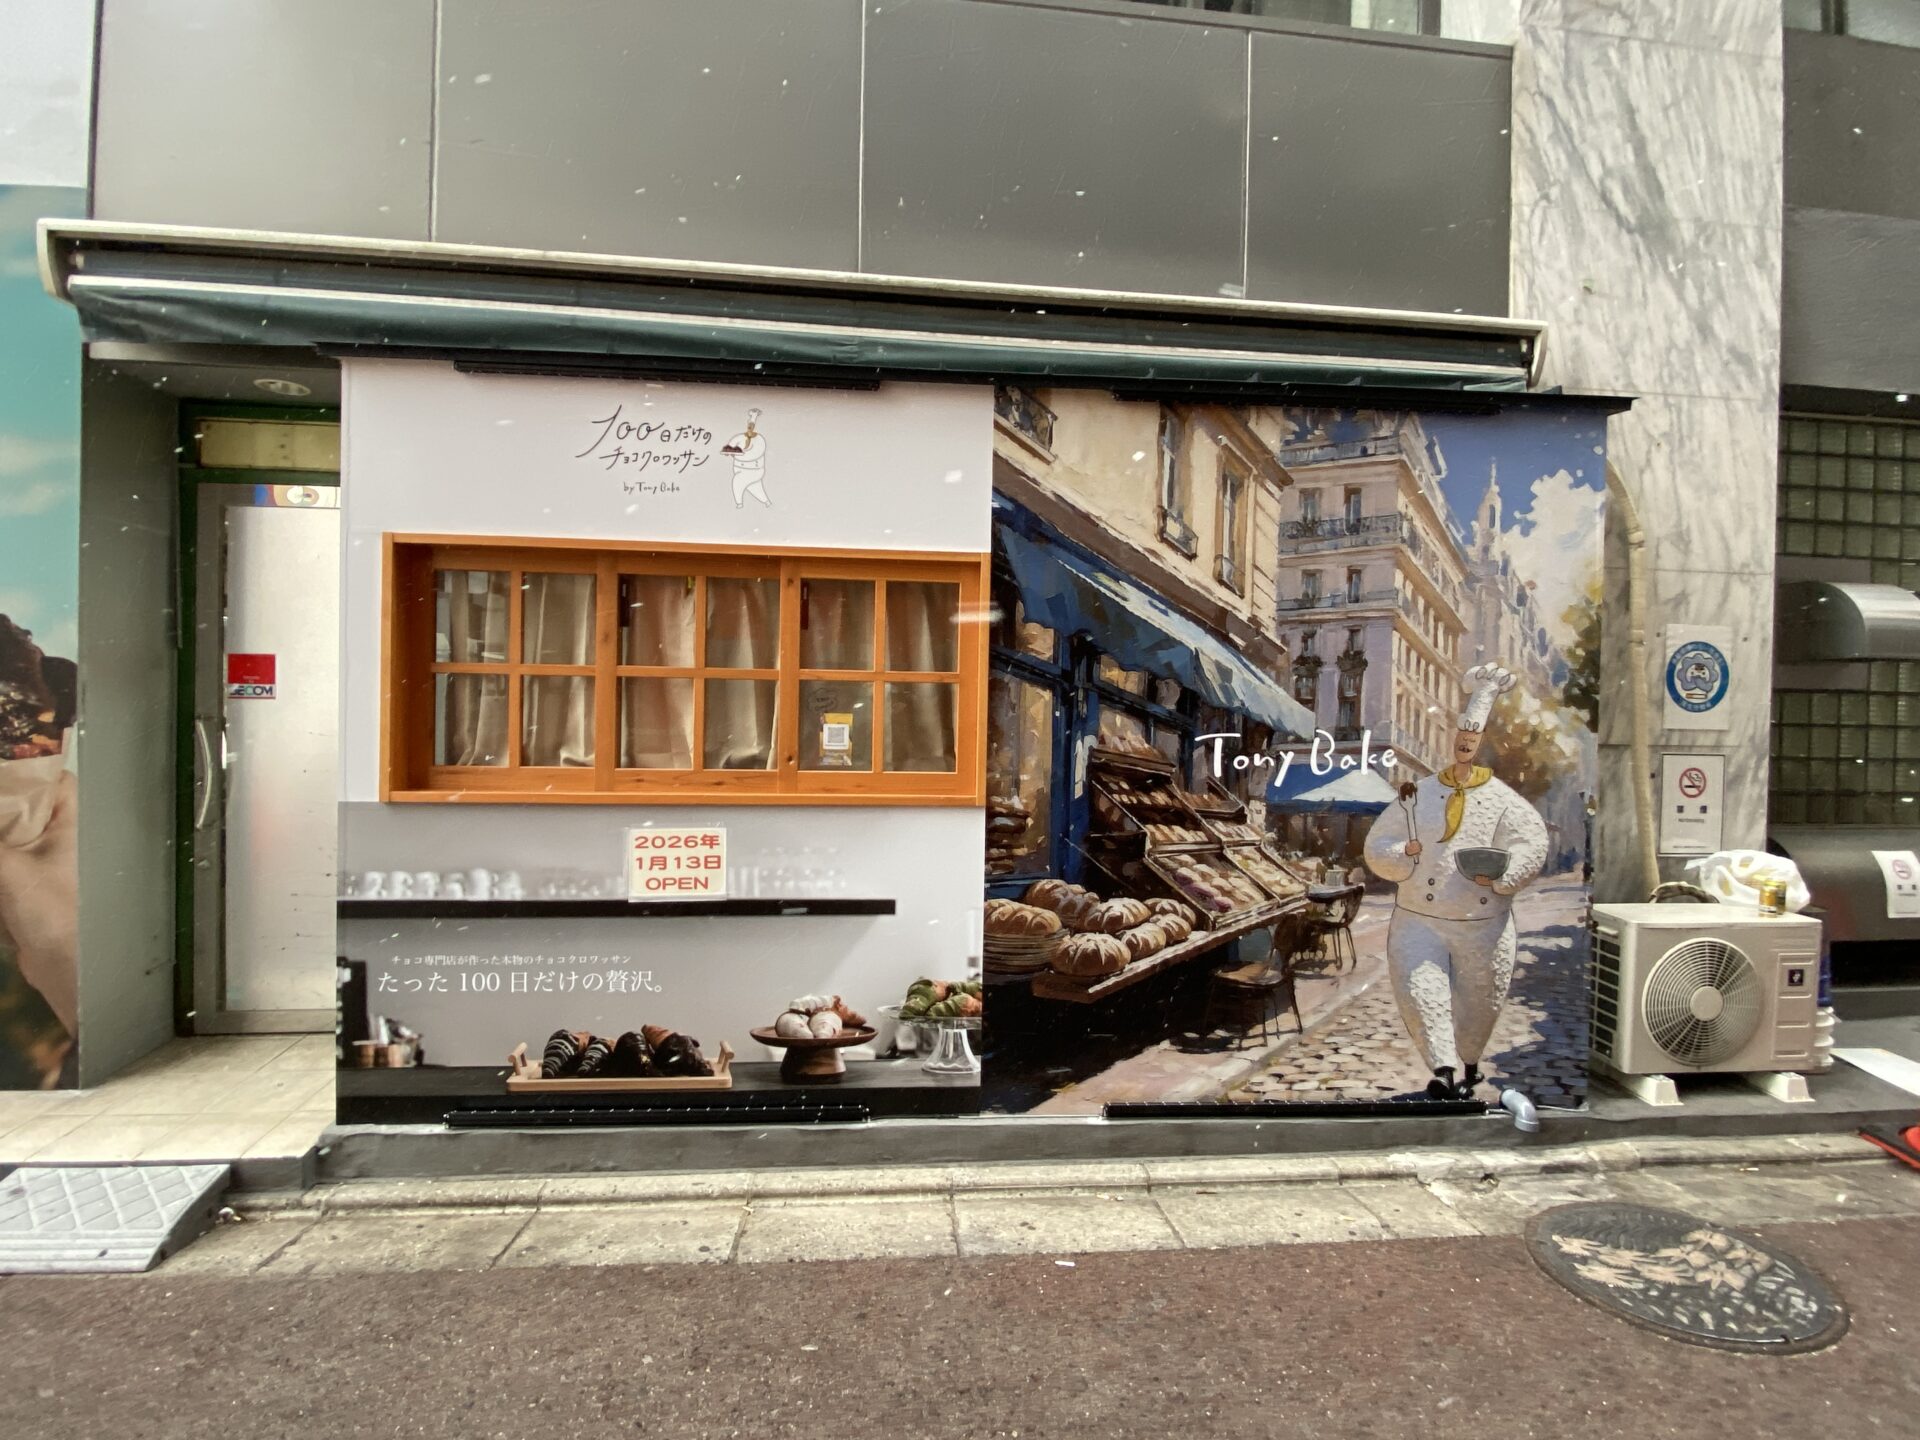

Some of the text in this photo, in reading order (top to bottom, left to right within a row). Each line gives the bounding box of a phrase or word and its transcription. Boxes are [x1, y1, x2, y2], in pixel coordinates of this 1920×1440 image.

[574, 404, 712, 458] 100日だけの
[600, 446, 710, 474] チョコクロワッサン
[623, 481, 635, 495] by
[635, 481, 658, 495] Tony
[229, 685, 273, 696] SECOM
[1194, 729, 1398, 788] Tony Bake
[634, 833, 721, 849] 2026年
[635, 855, 722, 871] 1月13日
[645, 876, 709, 891] OPEN
[391, 953, 633, 967] チョコ専門店が作った本物のチョコクロワッサン
